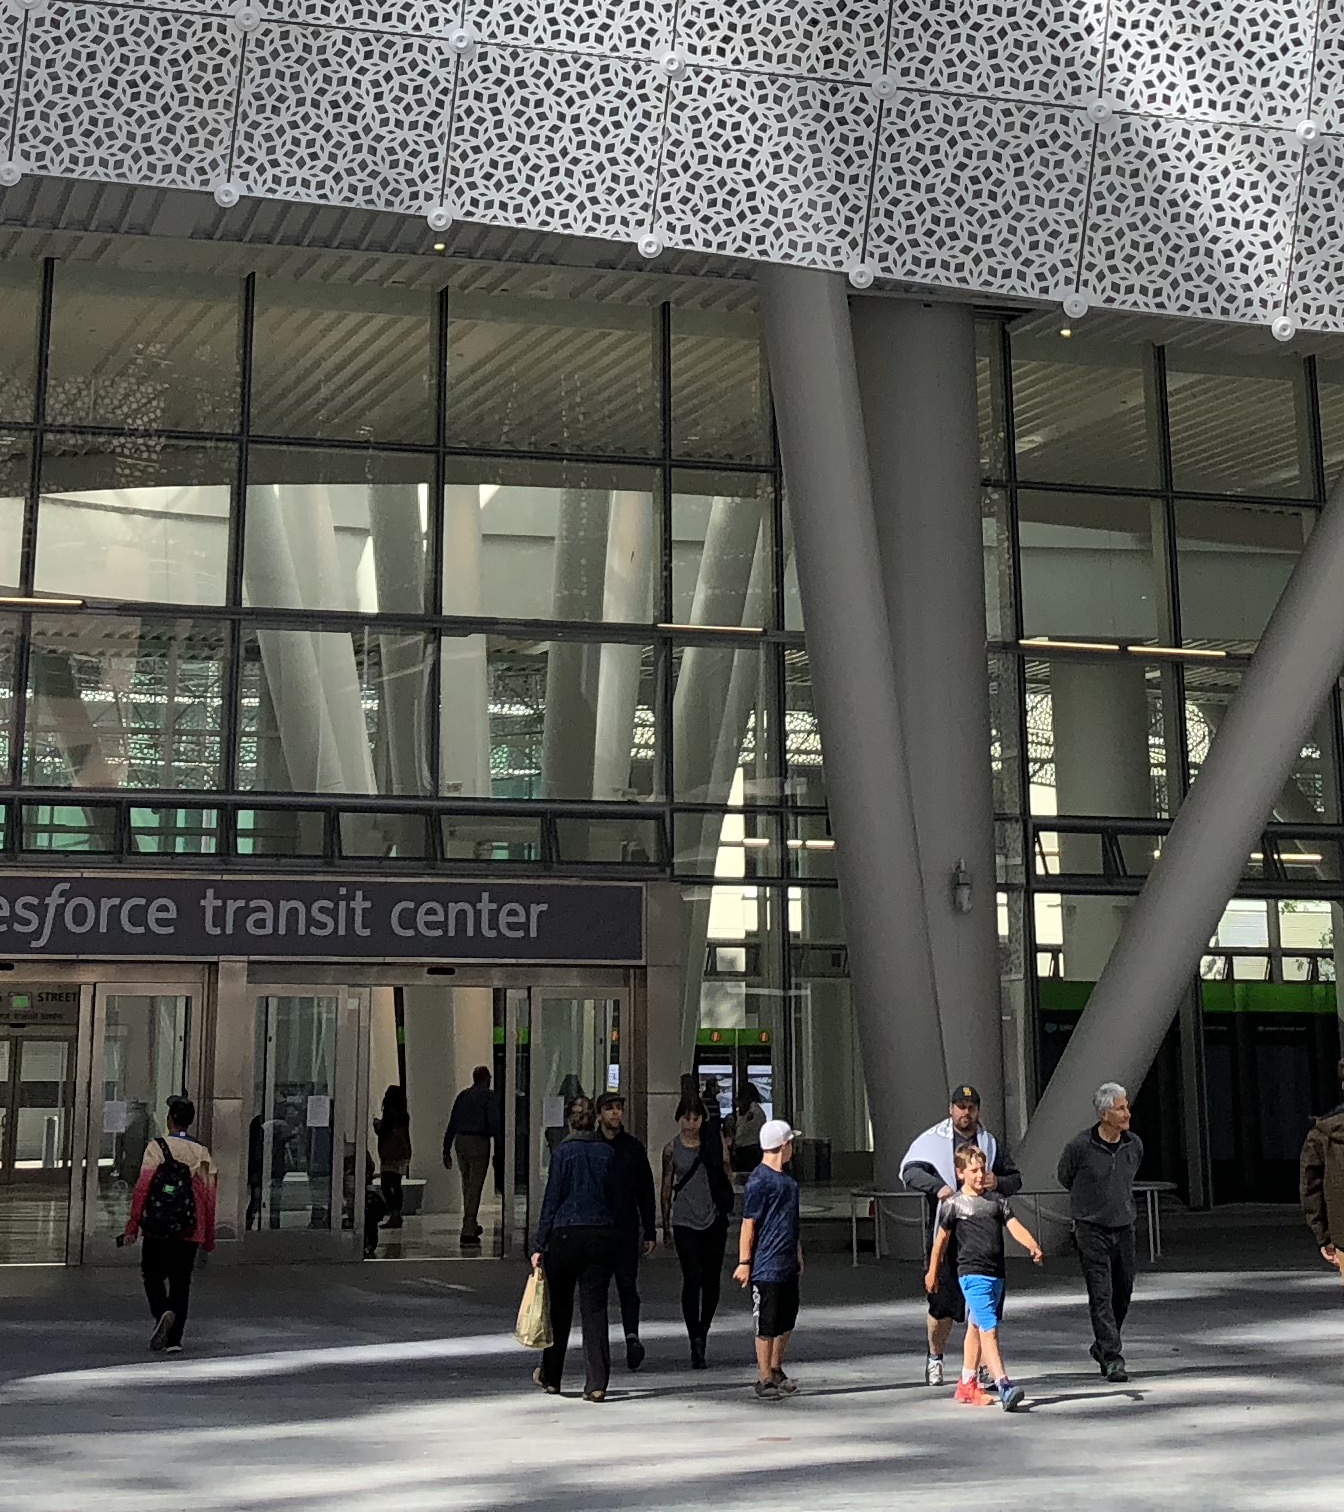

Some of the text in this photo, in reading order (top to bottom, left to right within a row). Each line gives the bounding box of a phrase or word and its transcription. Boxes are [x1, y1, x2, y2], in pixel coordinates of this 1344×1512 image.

[200, 887, 372, 938] transit
[390, 891, 549, 939] center
[37, 991, 78, 1003] STREET
